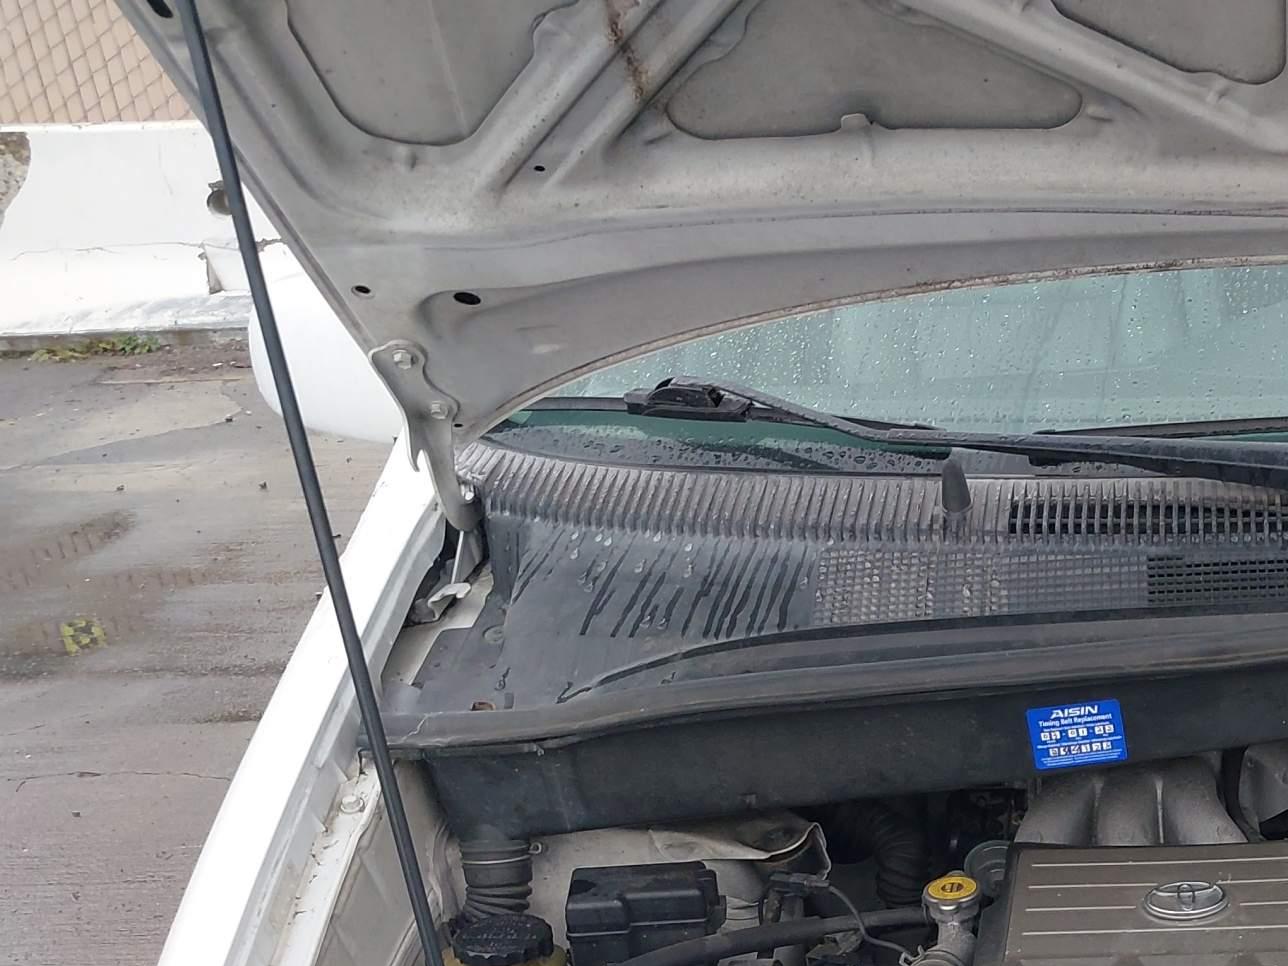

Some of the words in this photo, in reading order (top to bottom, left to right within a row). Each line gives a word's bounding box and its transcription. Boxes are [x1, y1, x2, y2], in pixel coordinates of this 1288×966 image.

[1050, 704, 1098, 720] AISIN
[1038, 719, 1060, 727] Timing
[1061, 717, 1073, 725] Belt
[1073, 713, 1113, 723] Replacement
